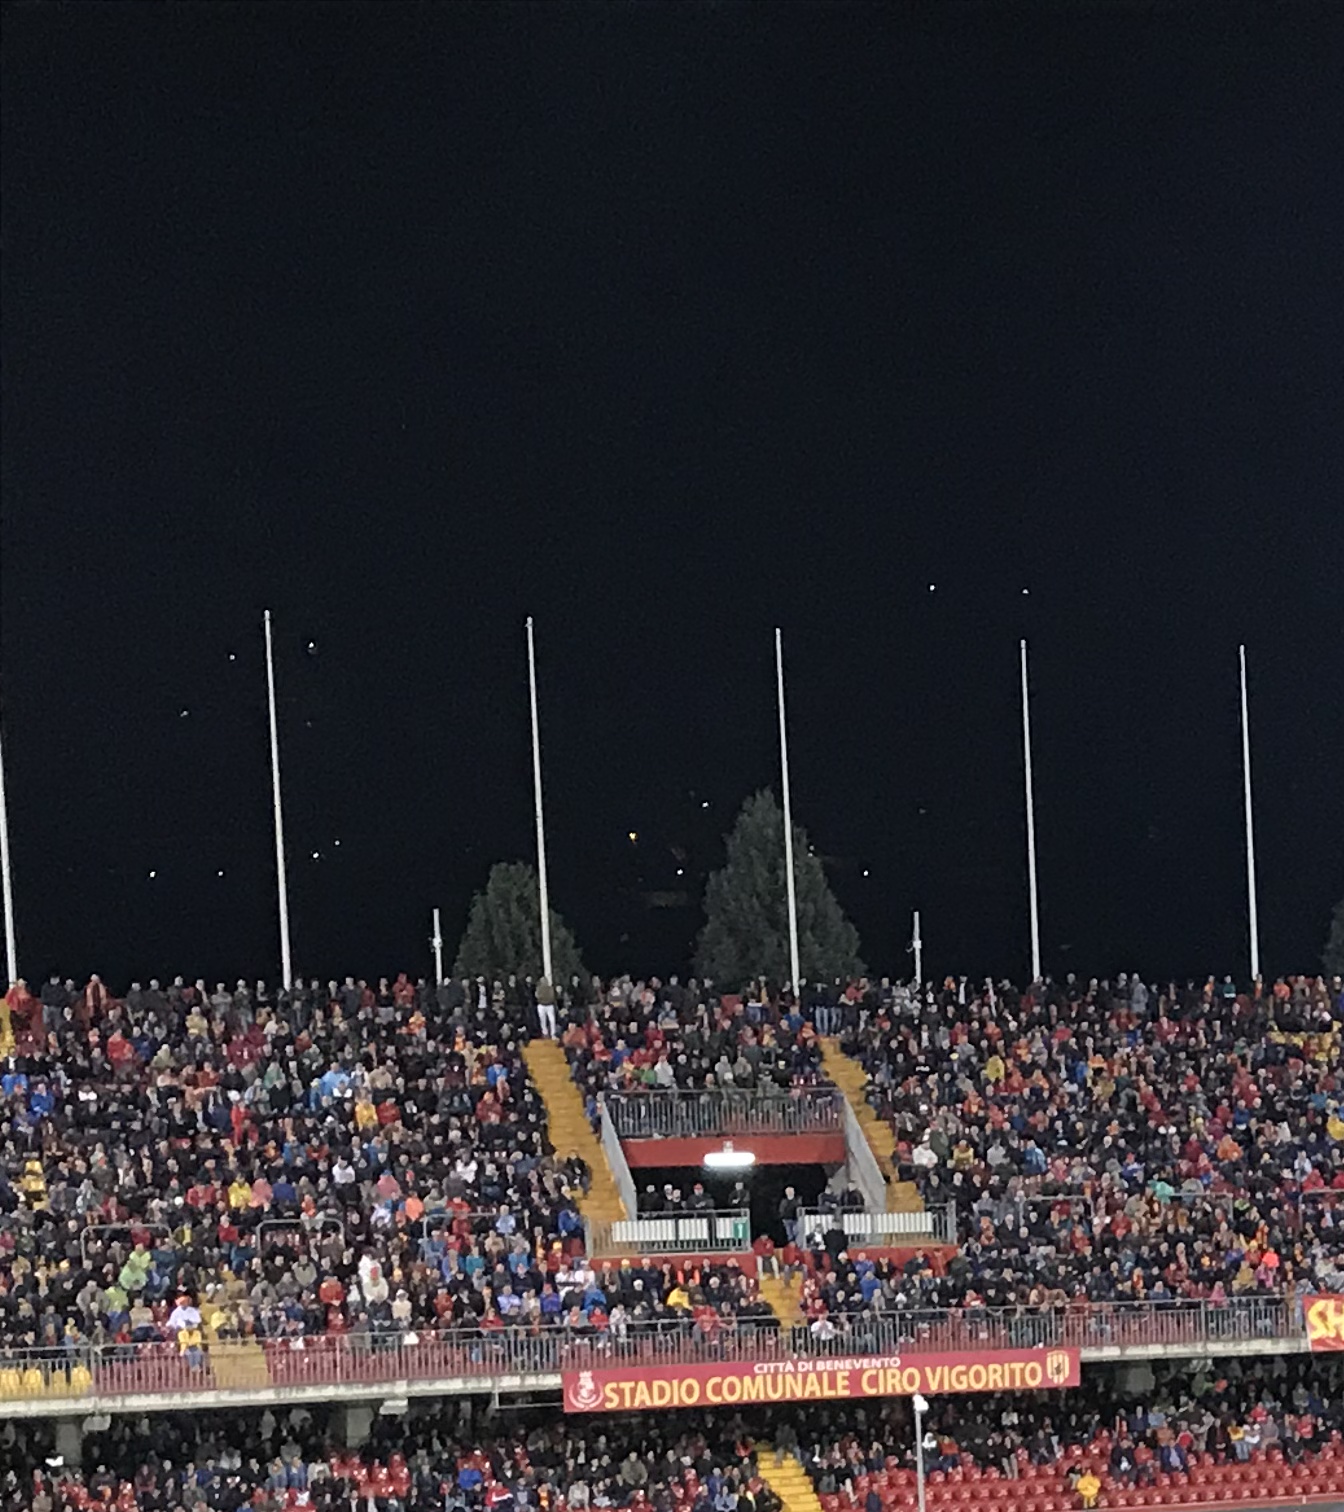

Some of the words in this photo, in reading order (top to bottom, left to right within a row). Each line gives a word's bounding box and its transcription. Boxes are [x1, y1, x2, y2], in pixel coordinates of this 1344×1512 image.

[754, 1359, 795, 1374] CITTÀ
[798, 1361, 814, 1373] DI
[816, 1356, 901, 1372] BENEVENTO
[604, 1378, 700, 1409] STADIO
[706, 1371, 850, 1401] COMUNALE
[861, 1367, 921, 1395] CIRO
[925, 1361, 1042, 1391] VIGORITO
